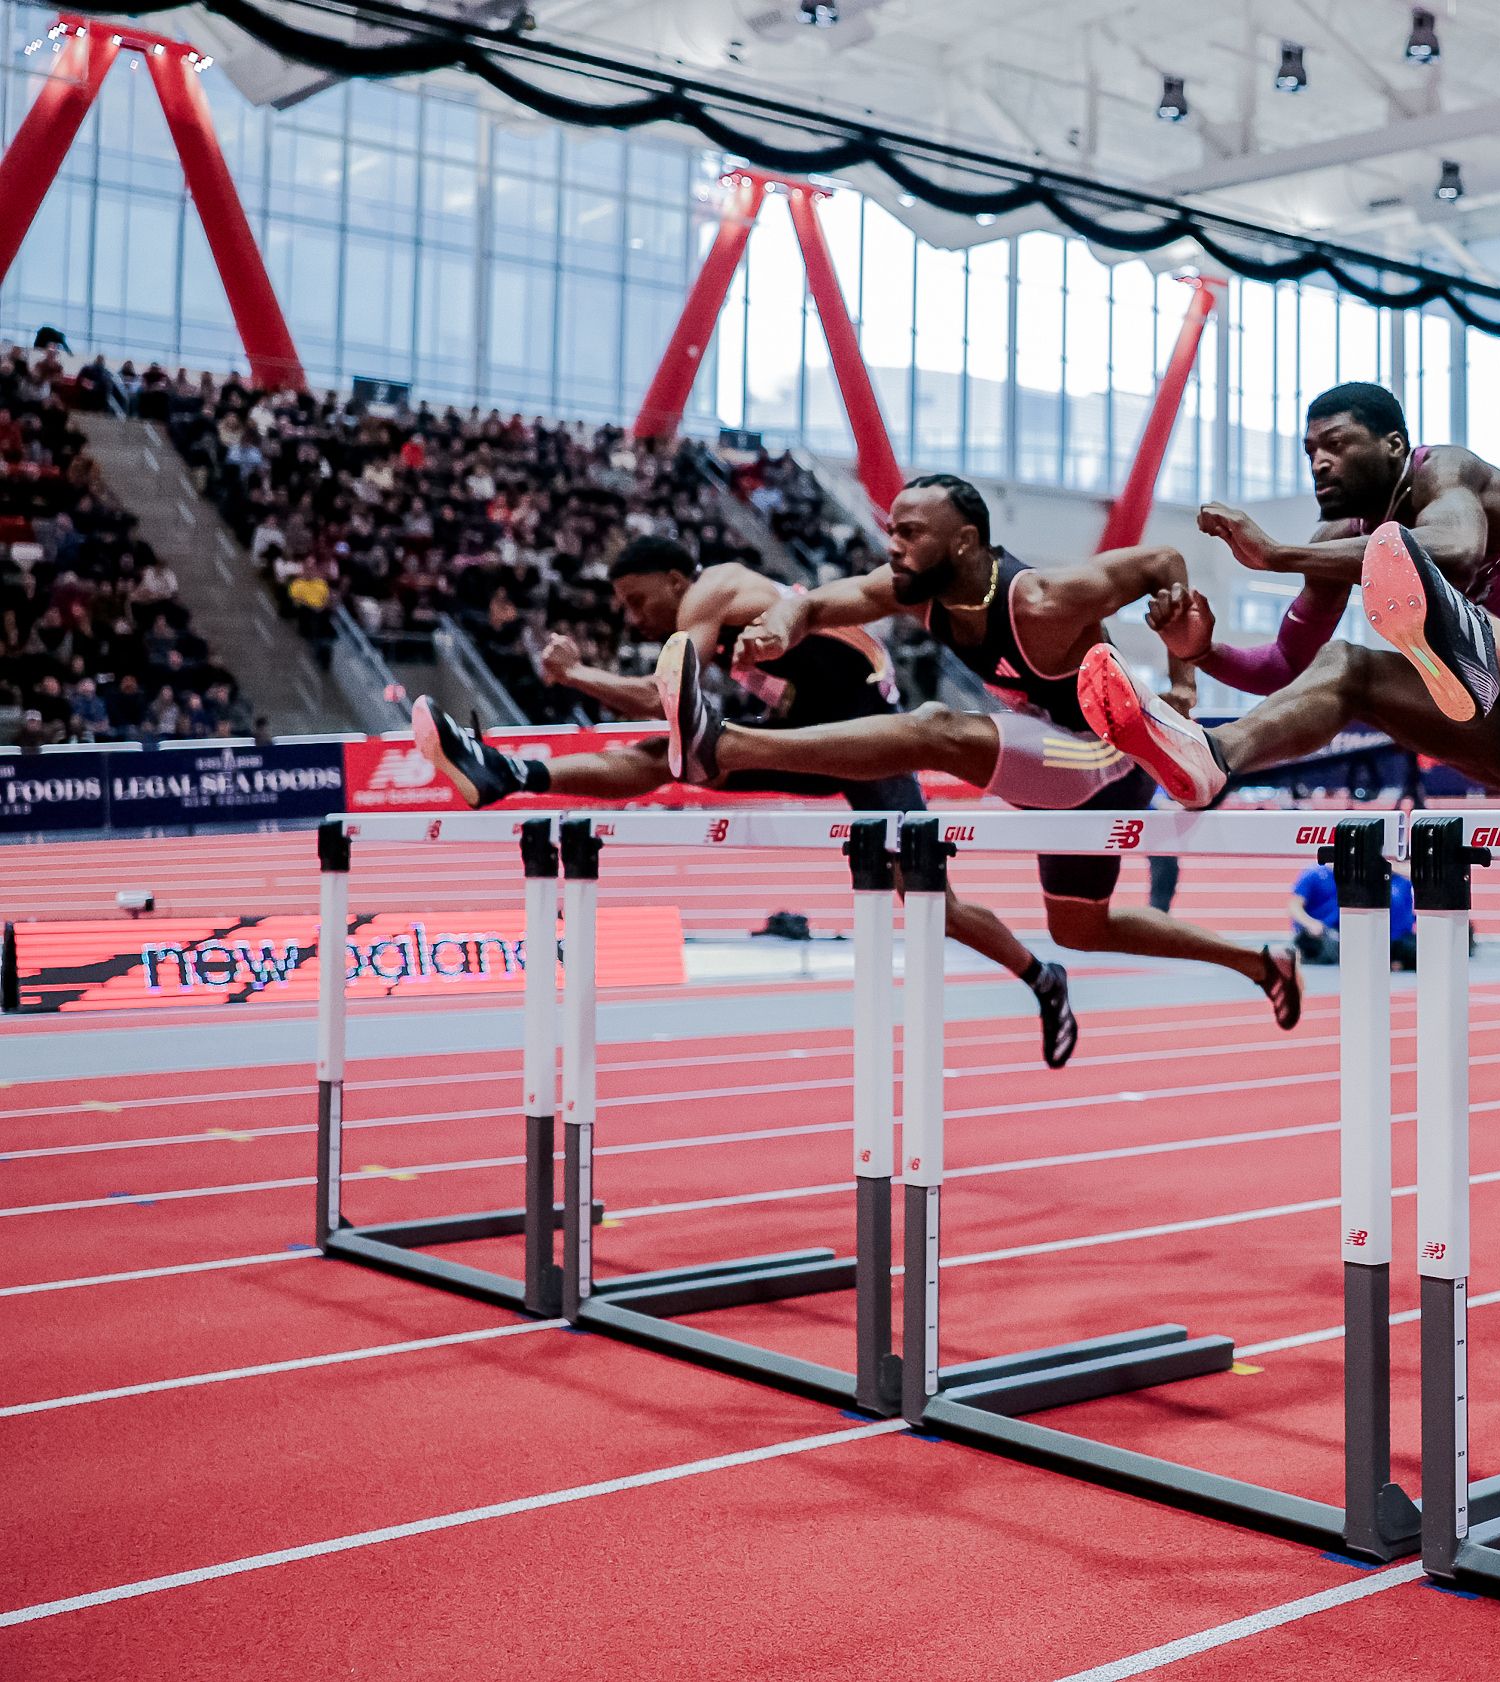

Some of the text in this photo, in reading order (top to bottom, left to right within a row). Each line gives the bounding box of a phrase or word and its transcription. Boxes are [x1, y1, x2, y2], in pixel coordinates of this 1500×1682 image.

[8, 777, 101, 803] FOODS
[114, 775, 198, 801] LEGAL
[254, 767, 341, 792] FOODS
[830, 825, 851, 838] GIL
[944, 826, 975, 841] GILL
[1105, 820, 1143, 849] NB
[142, 937, 299, 993] new
